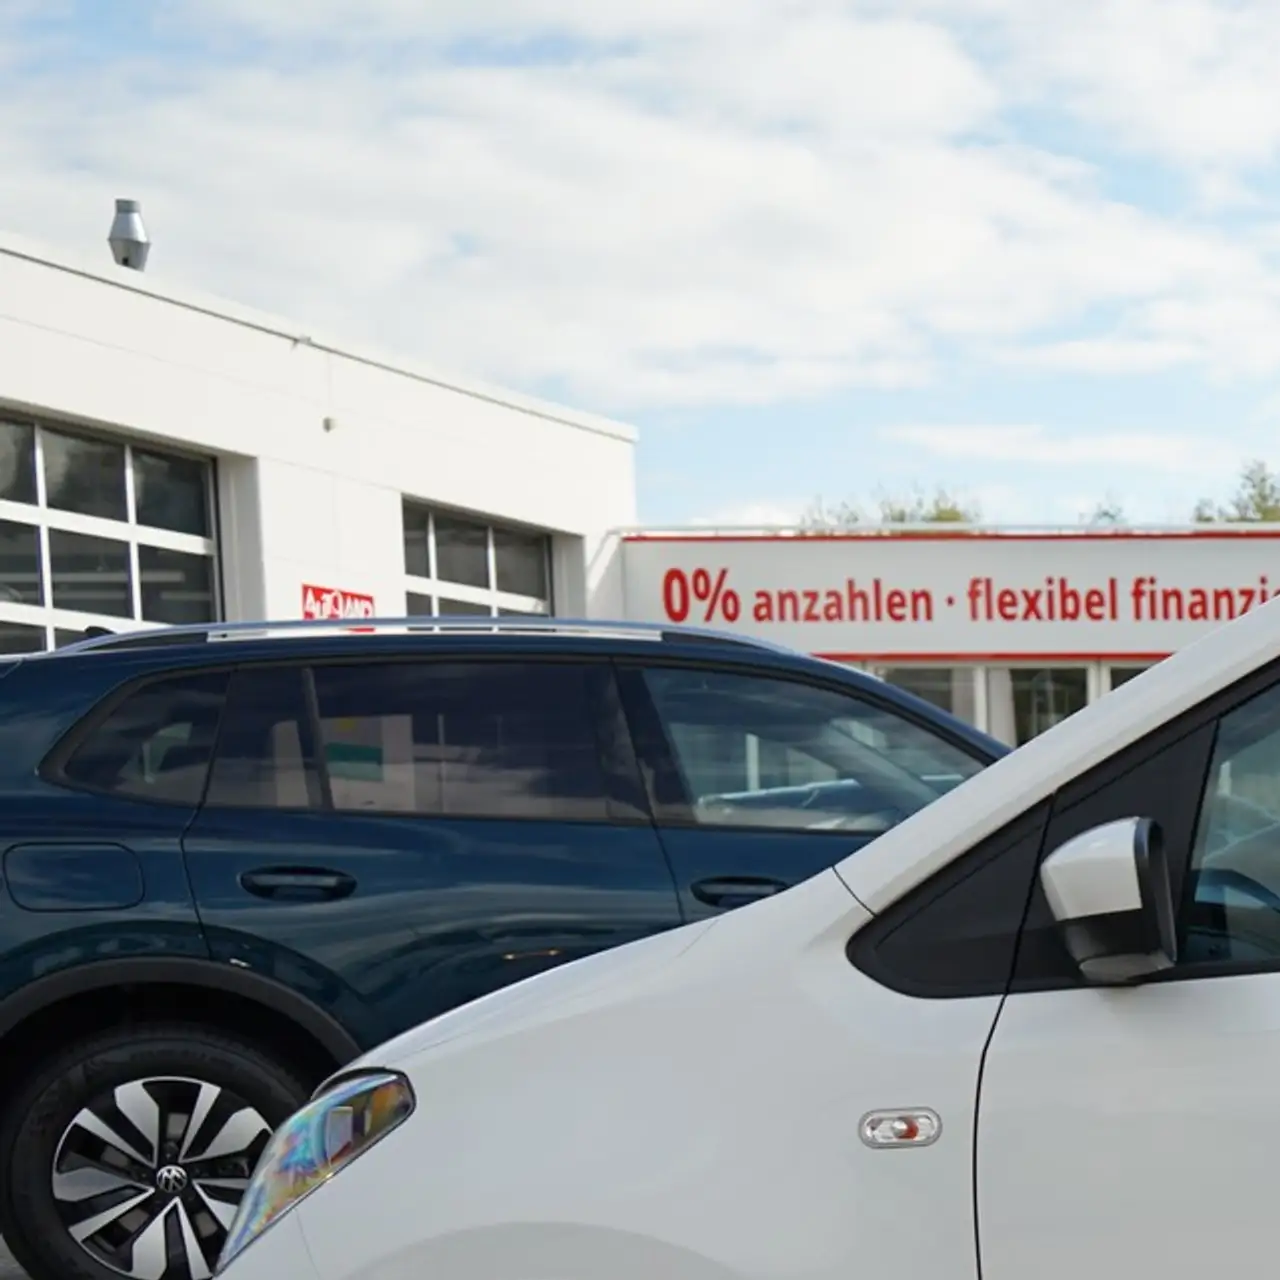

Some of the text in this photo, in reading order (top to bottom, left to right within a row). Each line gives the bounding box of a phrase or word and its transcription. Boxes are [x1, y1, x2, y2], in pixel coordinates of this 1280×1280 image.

[663, 567, 741, 623] 0%
[753, 578, 933, 623] anzahlen
[968, 577, 1119, 621] flexibel
